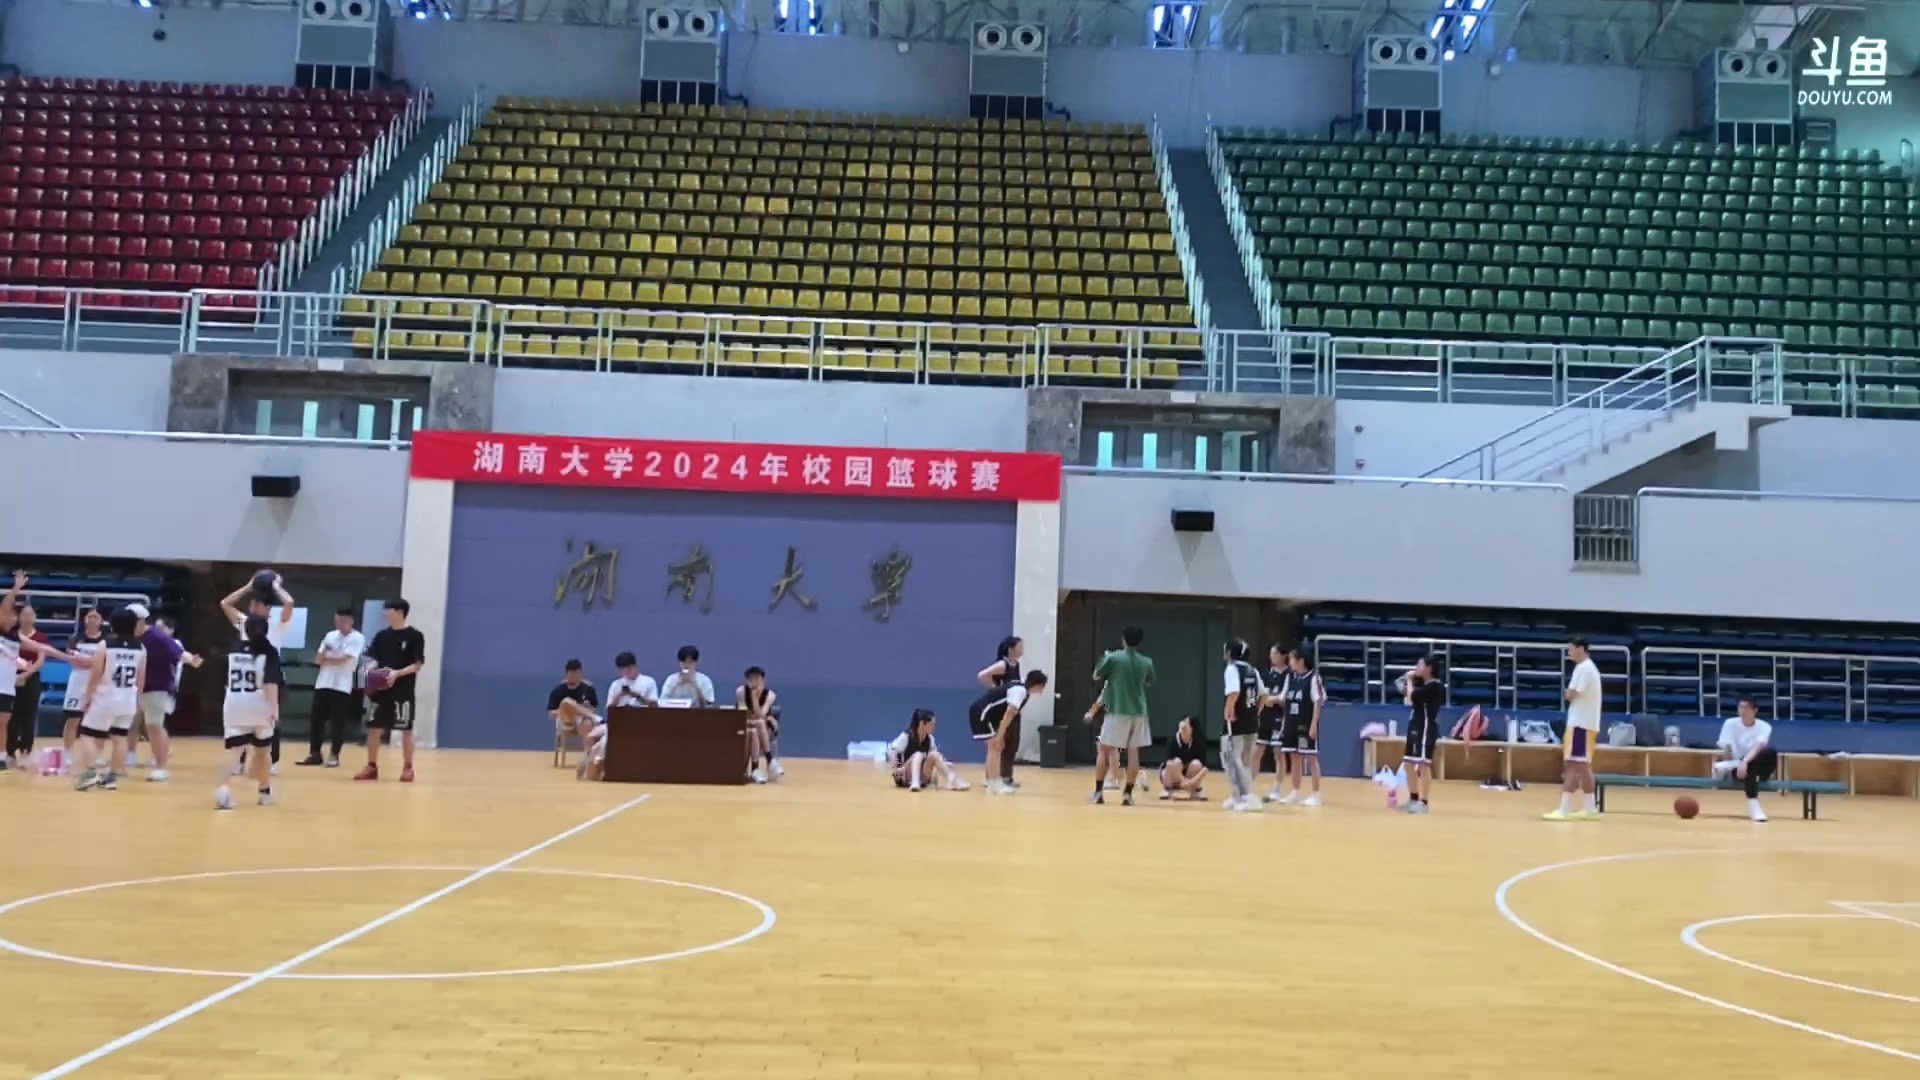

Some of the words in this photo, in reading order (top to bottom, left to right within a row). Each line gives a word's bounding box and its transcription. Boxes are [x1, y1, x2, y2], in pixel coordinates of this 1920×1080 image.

[473, 441, 1000, 491] 湖南大学2024年校园篮球赛
[112, 665, 136, 688] 42
[231, 669, 257, 692] 29
